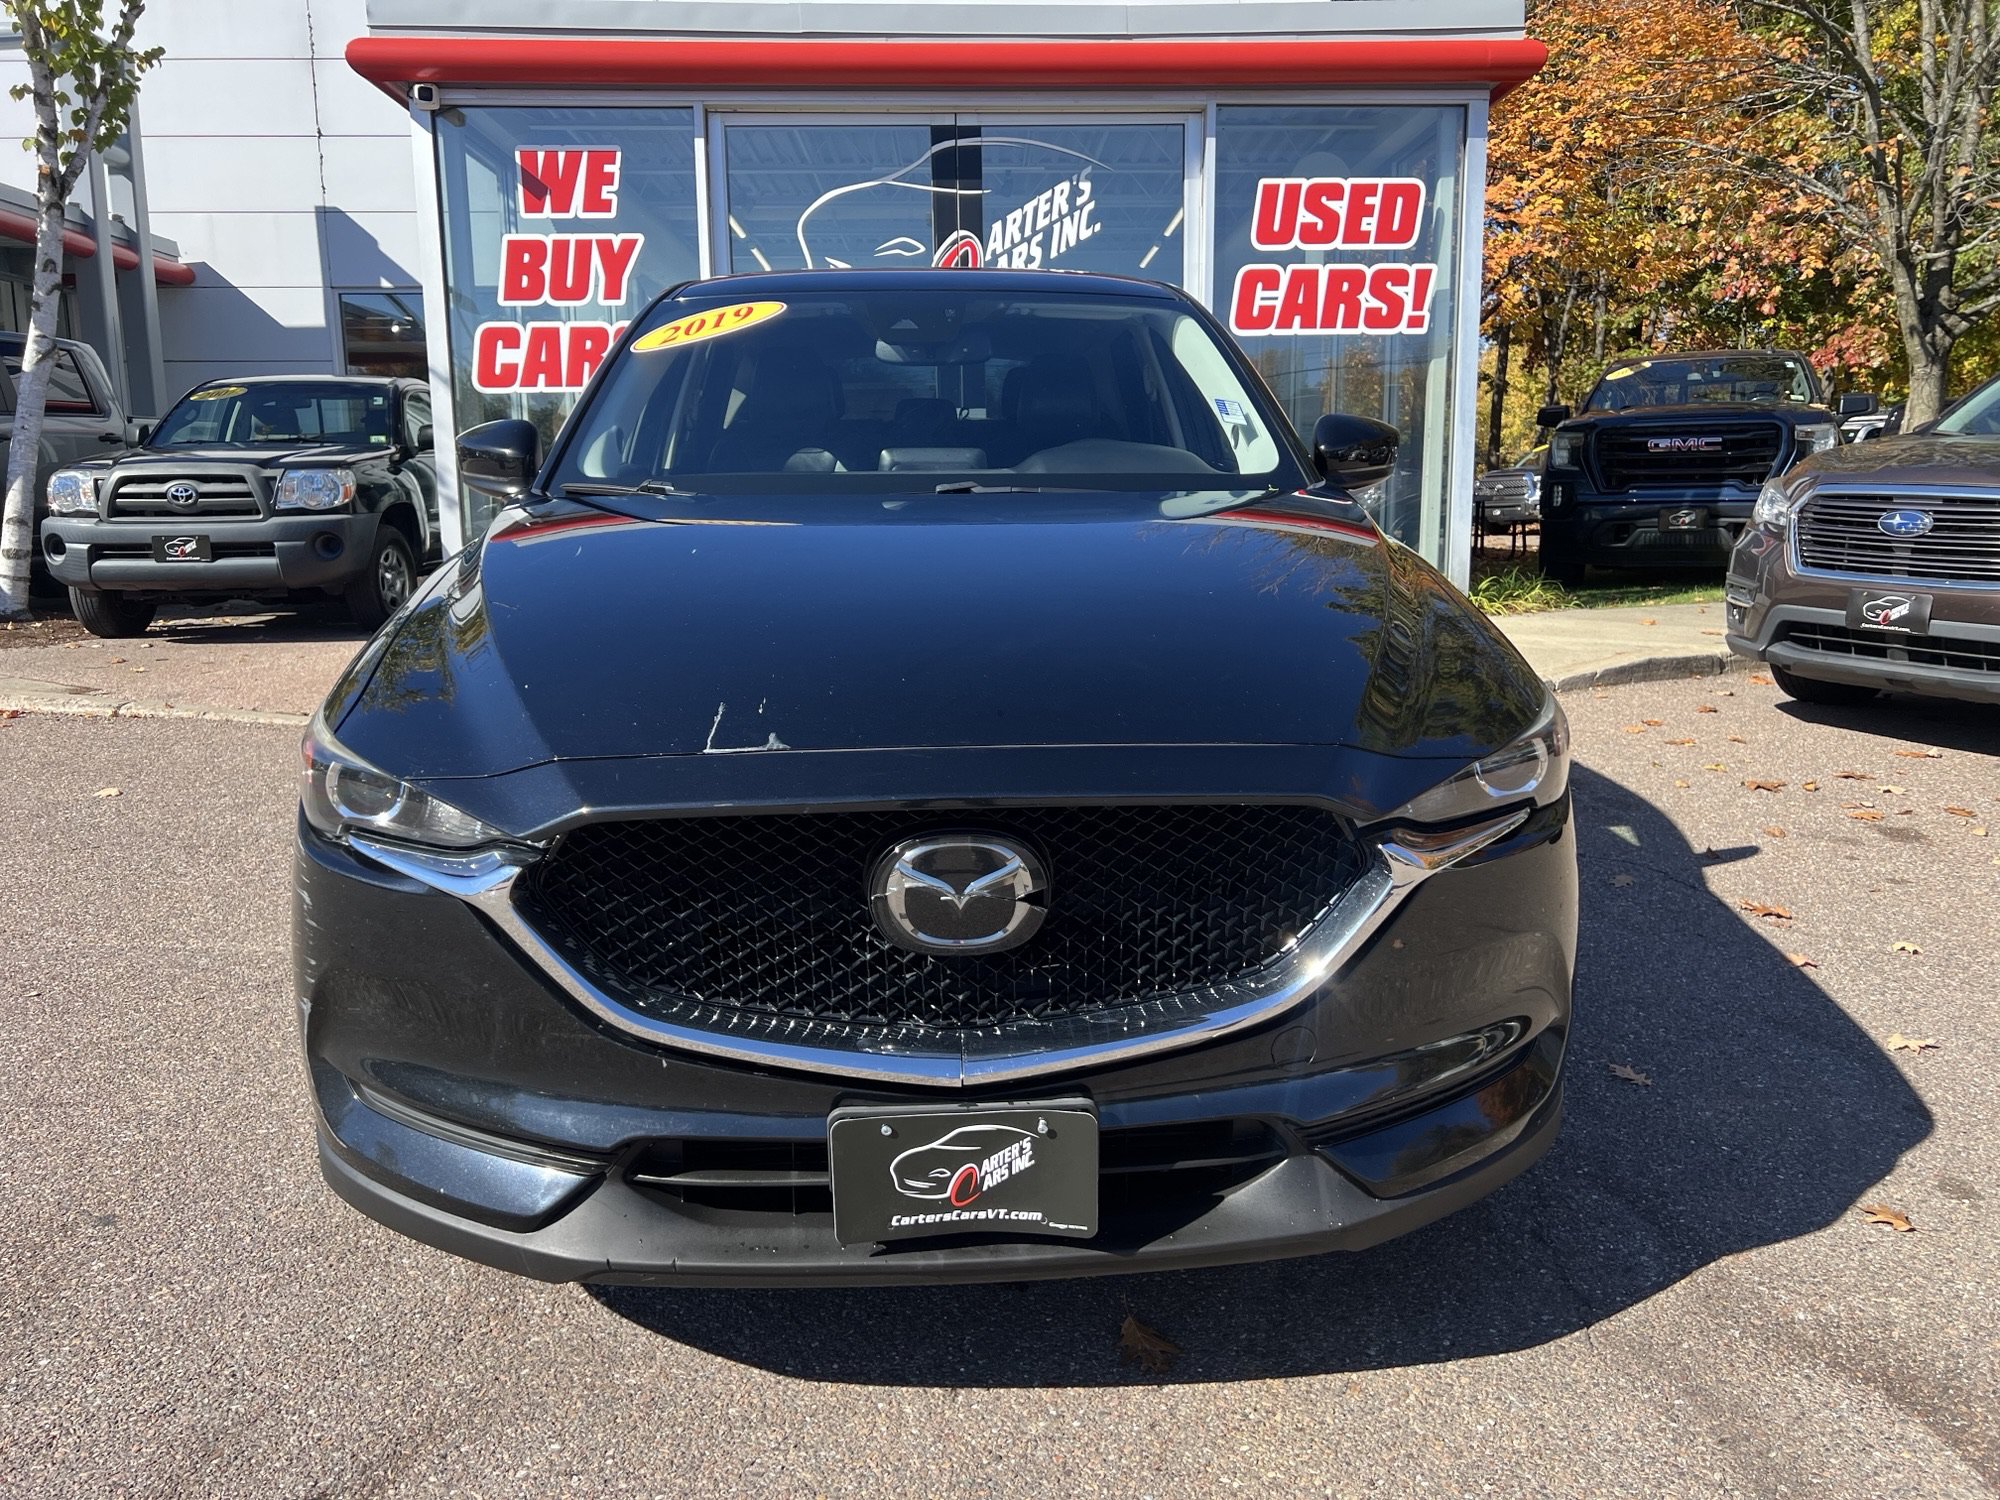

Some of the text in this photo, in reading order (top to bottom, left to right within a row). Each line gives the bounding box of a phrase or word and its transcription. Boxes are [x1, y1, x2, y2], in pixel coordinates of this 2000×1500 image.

[517, 149, 619, 216] WE
[1253, 180, 1423, 247] USED
[1050, 200, 1101, 259] INC.
[500, 236, 642, 303] BUY
[1231, 265, 1435, 332] CARS!
[473, 323, 628, 391] CAR
[658, 306, 754, 345] 2019
[1647, 437, 1722, 452] GMC
[891, 1208, 1042, 1226] CartersCarsVT.com
